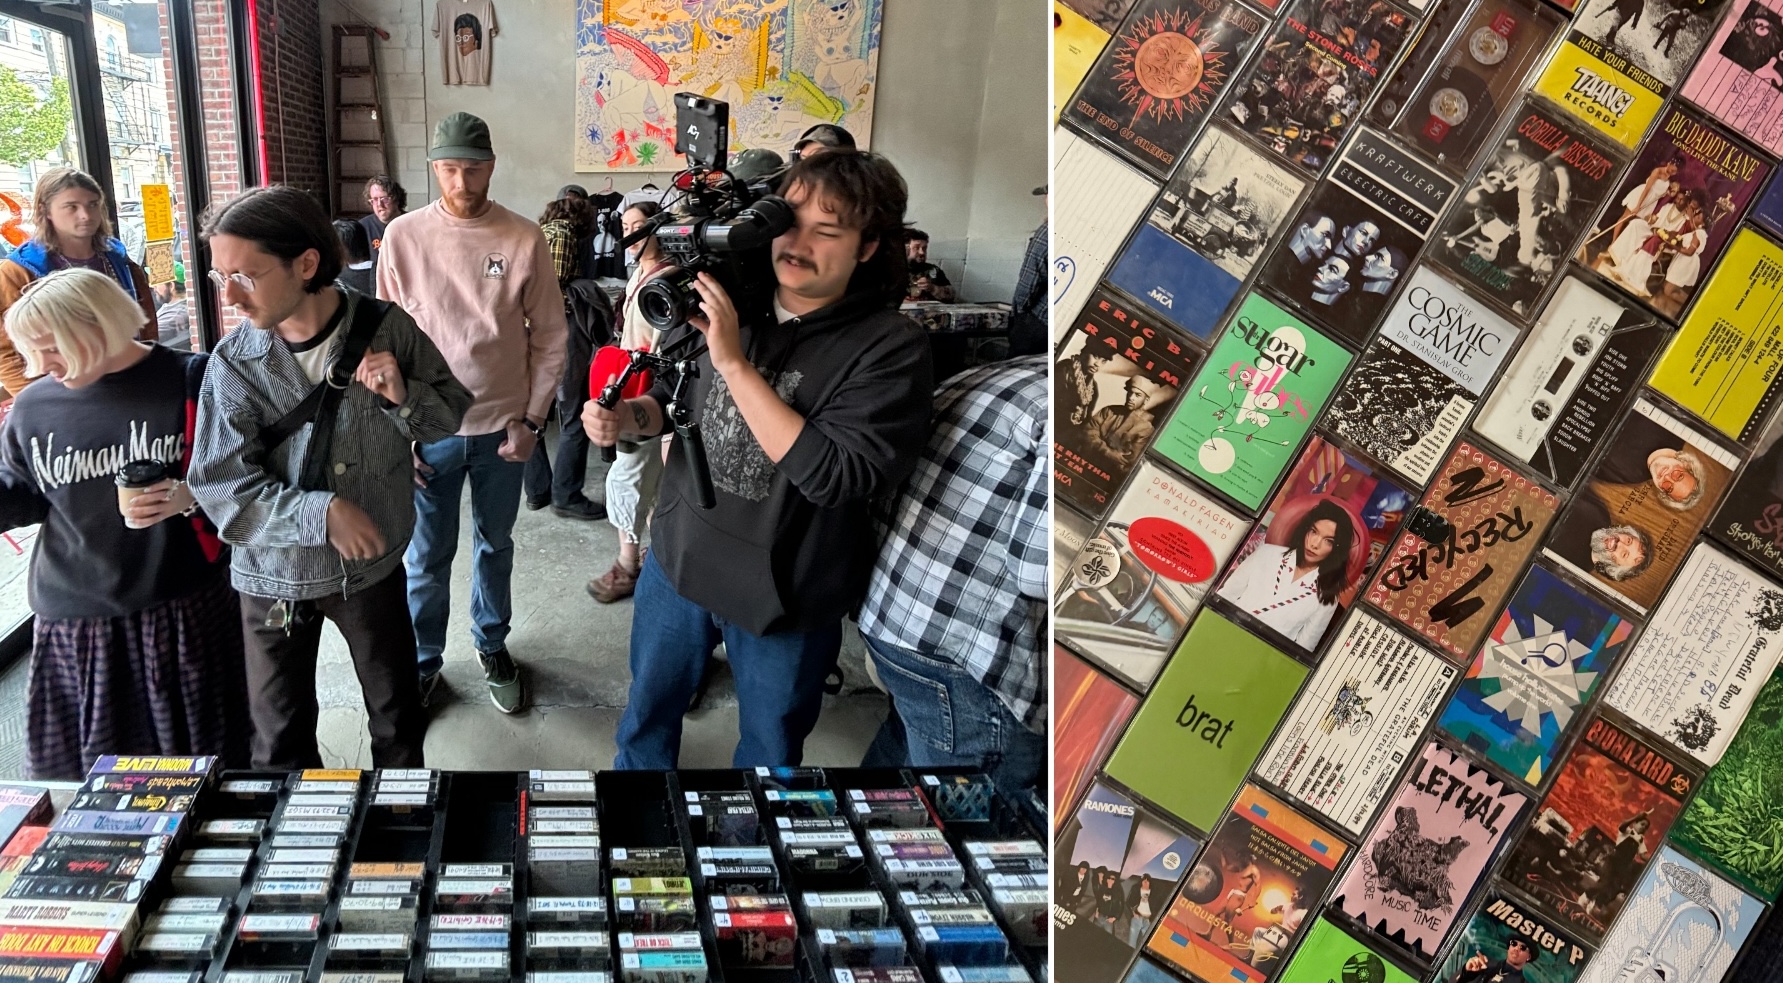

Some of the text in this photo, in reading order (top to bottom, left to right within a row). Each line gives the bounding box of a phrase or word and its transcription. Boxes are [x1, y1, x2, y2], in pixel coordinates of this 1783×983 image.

[1219, 3, 1261, 37] BAND
[1285, 16, 1379, 77] THE STONE ROSES
[1303, 40, 1347, 71] Second Coming
[1439, 48, 1464, 80] maxell
[1577, 35, 1664, 94] HATE YOUR FRIENDS
[1574, 66, 1636, 119] TAANG!
[1729, 69, 1749, 95] NFA
[1564, 91, 1617, 128] RECORDS
[1075, 99, 1174, 165] THE END OF SILENCE
[1428, 121, 1443, 137] 90
[1663, 110, 1759, 182] BIG DADDY KANE
[1518, 113, 1613, 181] GORILLA BISCUITS
[1671, 138, 1737, 182] LONG LIVE THE KANE
[1265, 173, 1296, 195] STEELY DAN
[1354, 140, 1445, 202] KRAFTWERK
[1339, 166, 1429, 227] ELECTRIC CAFE
[1149, 289, 1175, 309] MCA
[1455, 302, 1473, 317] THE
[1098, 299, 1156, 340] ERIC
[1407, 287, 1500, 357] COSMIC
[1770, 323, 1781, 336] 422
[1084, 322, 1181, 386] RAKIM
[1231, 316, 1315, 378] sugar
[1376, 336, 1402, 355] PART ONE
[1408, 313, 1480, 368] GAME
[1743, 339, 1755, 353] SIDE
[1753, 347, 1766, 365] 124-4
[1766, 339, 1781, 358] MALL
[1410, 339, 1452, 369] STANISLAV
[1450, 365, 1474, 384] GROF
[1761, 348, 1783, 382] OF FOUR
[31, 420, 184, 493] Neiman Marc
[1065, 449, 1111, 481] RHYTHM
[1145, 487, 1227, 540] KAMAKIRIAD
[1152, 476, 1198, 508] DONALD
[1198, 504, 1234, 530] FAGEN
[1618, 486, 1639, 515] GARCIA
[1654, 517, 1679, 552] GRISMAN
[1657, 536, 1676, 562] DAVID
[1498, 658, 1523, 678] house
[1734, 635, 1769, 682] Grateful
[1500, 672, 1552, 707] pump up the world
[1505, 687, 1527, 703] volume
[1716, 682, 1740, 711] Dead
[1175, 694, 1237, 750] brat
[1360, 696, 1411, 775] THE GRATEFUL DEAD
[113, 757, 194, 771] MADONNA LIVE
[1376, 749, 1387, 763] WITH
[1586, 721, 1674, 785] BIOHAZARD
[147, 775, 200, 790] Lemonheads
[1330, 775, 1346, 796] SPACE
[1409, 758, 1506, 840] LETHAL
[1084, 799, 1135, 817] RAMONES
[1249, 833, 1260, 842] HOT
[1260, 839, 1278, 853] SALSA
[1277, 849, 1292, 861] FROM
[1359, 850, 1377, 900] HARDCORE
[5, 905, 36, 920] MARTY
[1177, 896, 1234, 936] ORQUESTA
[1233, 930, 1244, 940] DE
[1381, 895, 1442, 932] MUSIC TIME
[28, 935, 51, 953] ANY
[52, 935, 68, 953] ON
[69, 935, 101, 953] KNOCK
[1486, 899, 1585, 970] Master P
